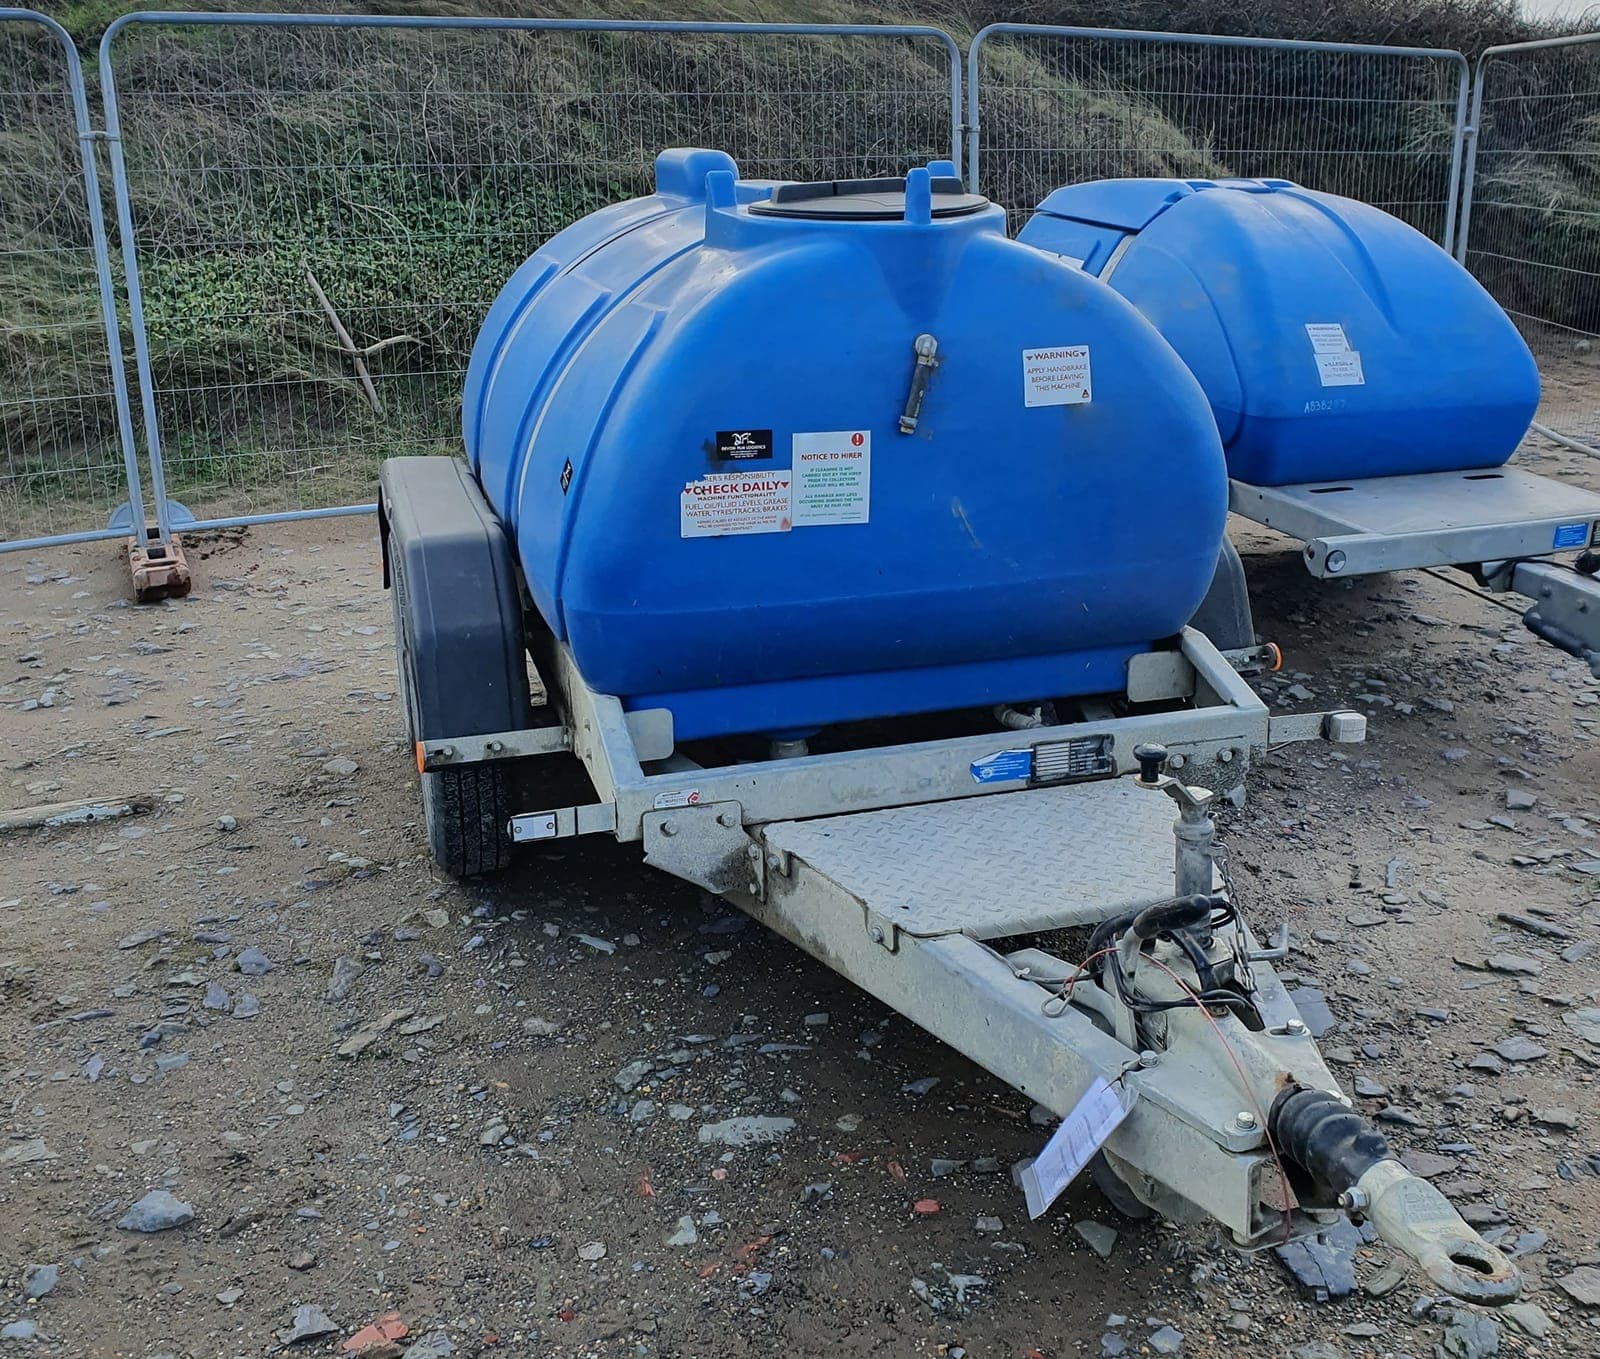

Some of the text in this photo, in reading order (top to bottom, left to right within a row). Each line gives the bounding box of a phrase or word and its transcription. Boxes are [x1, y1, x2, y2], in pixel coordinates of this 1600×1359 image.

[1034, 350, 1079, 360] WARNING
[1046, 364, 1088, 372] HANDBRAKE
[1057, 373, 1084, 381] LEAVING
[724, 472, 775, 480] RESPONSIBILITY
[693, 481, 780, 496] CHECK DAILY
